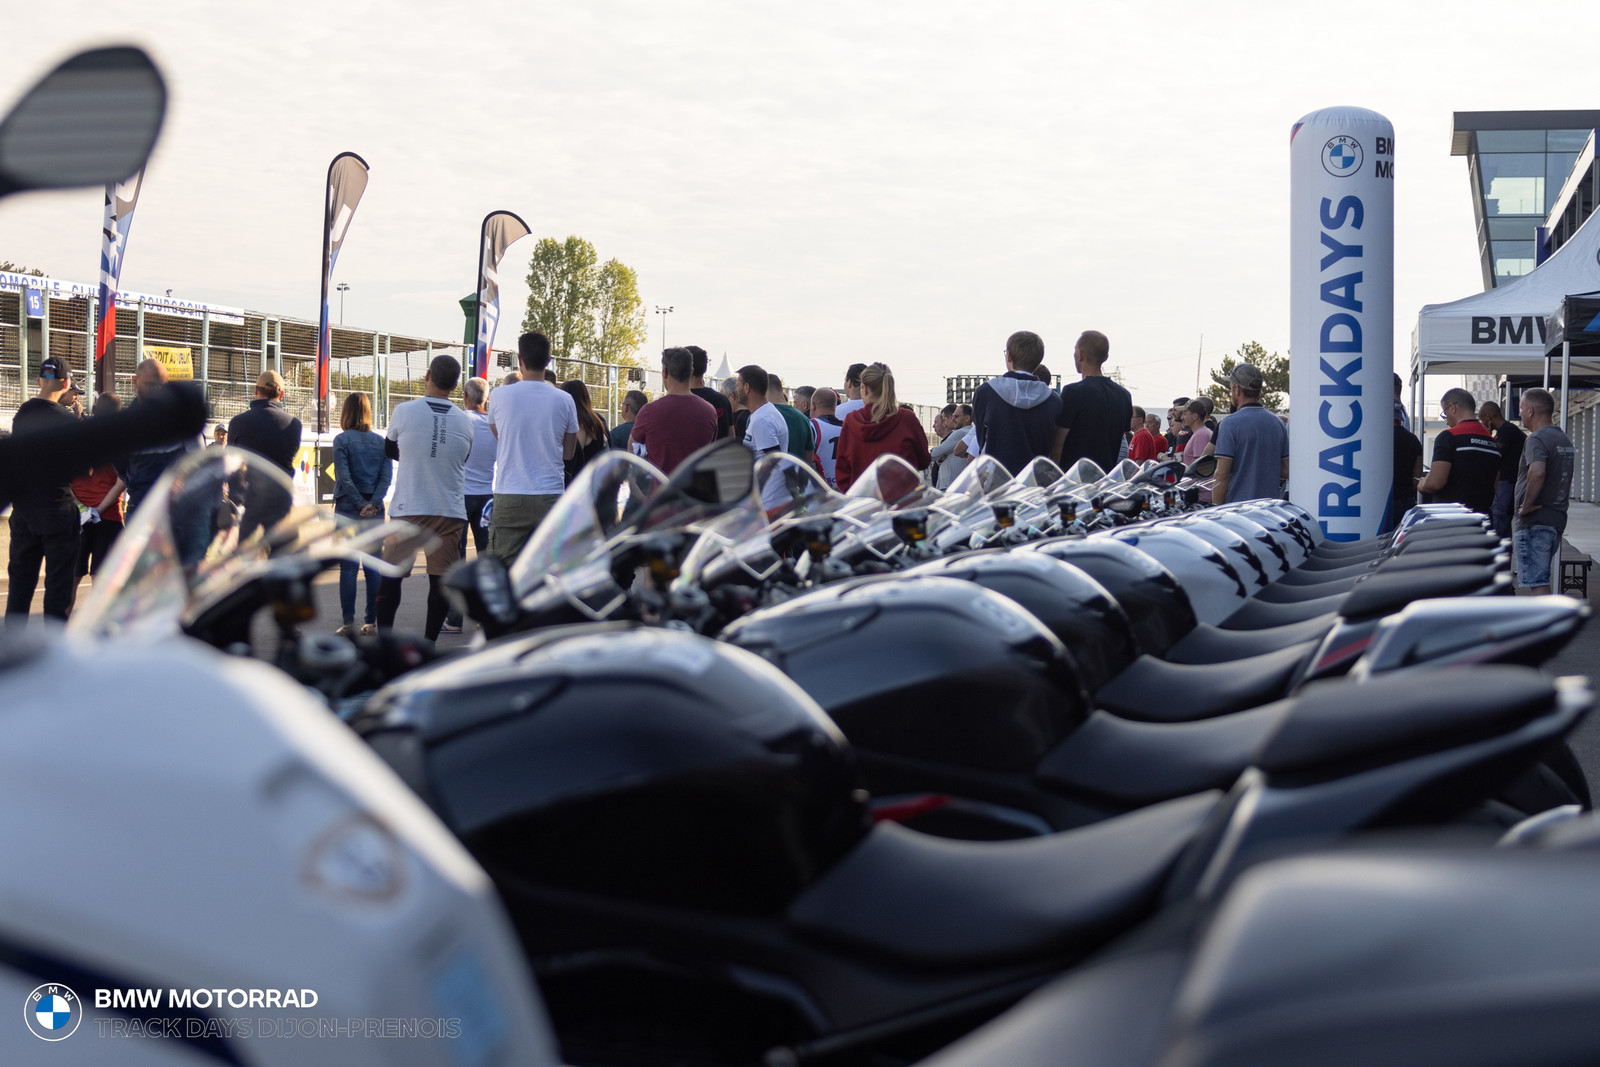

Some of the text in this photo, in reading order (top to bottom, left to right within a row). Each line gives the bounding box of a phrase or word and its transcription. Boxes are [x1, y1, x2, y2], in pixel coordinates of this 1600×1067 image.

[1327, 137, 1358, 149] BMW
[29, 295, 40, 310] 15
[1471, 316, 1546, 344] BM
[1318, 194, 1365, 542] TRACKDAYS
